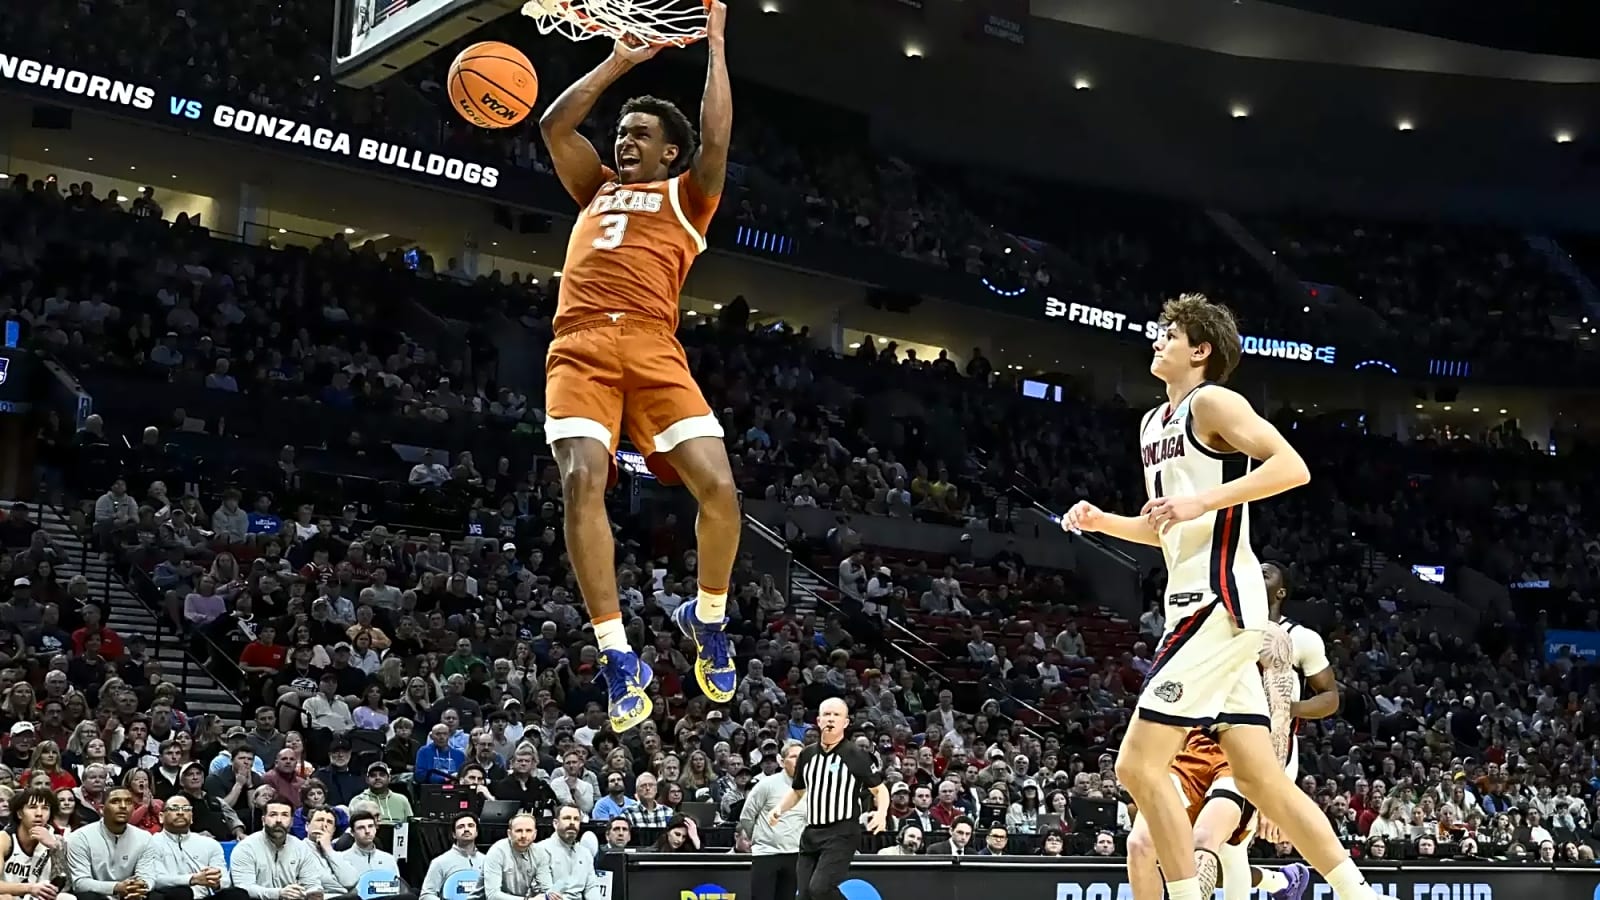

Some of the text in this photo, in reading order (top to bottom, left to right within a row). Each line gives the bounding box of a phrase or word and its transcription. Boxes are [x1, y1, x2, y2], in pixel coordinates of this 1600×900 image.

[480, 92, 519, 121] NCAA
[169, 96, 203, 119] VS
[213, 104, 351, 155] GONZAGA
[358, 138, 499, 188] BULLDOGS
[592, 213, 629, 250] 3
[1068, 302, 1127, 332] FIRST
[1142, 433, 1186, 468] ONZAGA
[4, 861, 31, 877] GONZ
